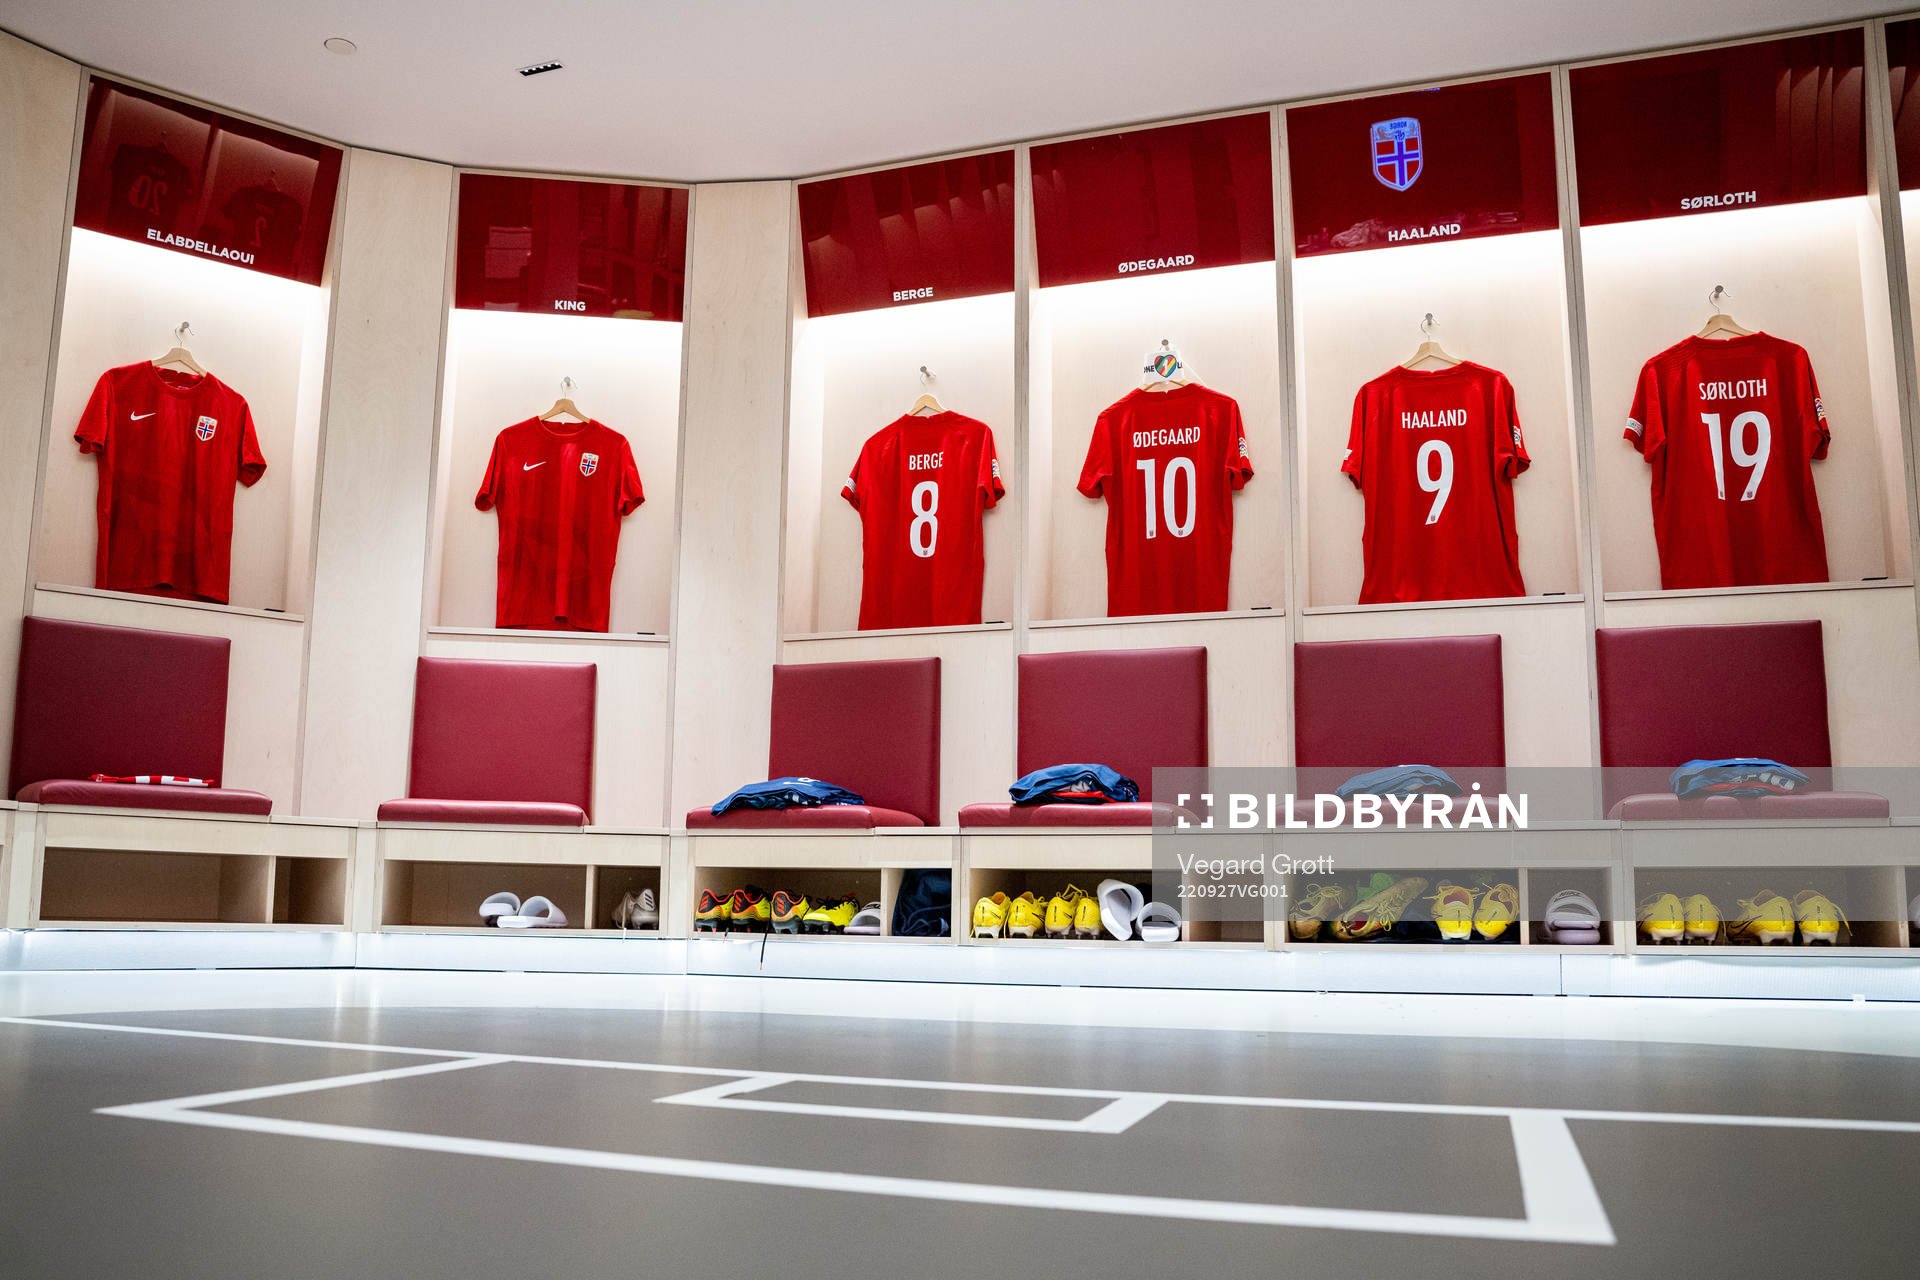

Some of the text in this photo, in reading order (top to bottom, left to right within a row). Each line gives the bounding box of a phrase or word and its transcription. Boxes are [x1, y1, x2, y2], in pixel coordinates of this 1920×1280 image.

[1681, 190, 1757, 211] SØRLOTH
[1388, 223, 1461, 242] HAALAND
[147, 228, 255, 264] ELABDELLAOUI
[1117, 254, 1195, 273] ØDEGAARD
[893, 287, 934, 302] BERGE
[554, 300, 586, 312] KING
[1699, 379, 1767, 401] SØRLOTH
[1401, 409, 1467, 429] HAALAND
[1133, 426, 1201, 448] ØDEGAARD
[908, 452, 944, 471] BERGE
[1701, 411, 1772, 502] 19
[1416, 440, 1454, 526] 9
[1136, 457, 1197, 540] 10
[910, 480, 939, 558] 8
